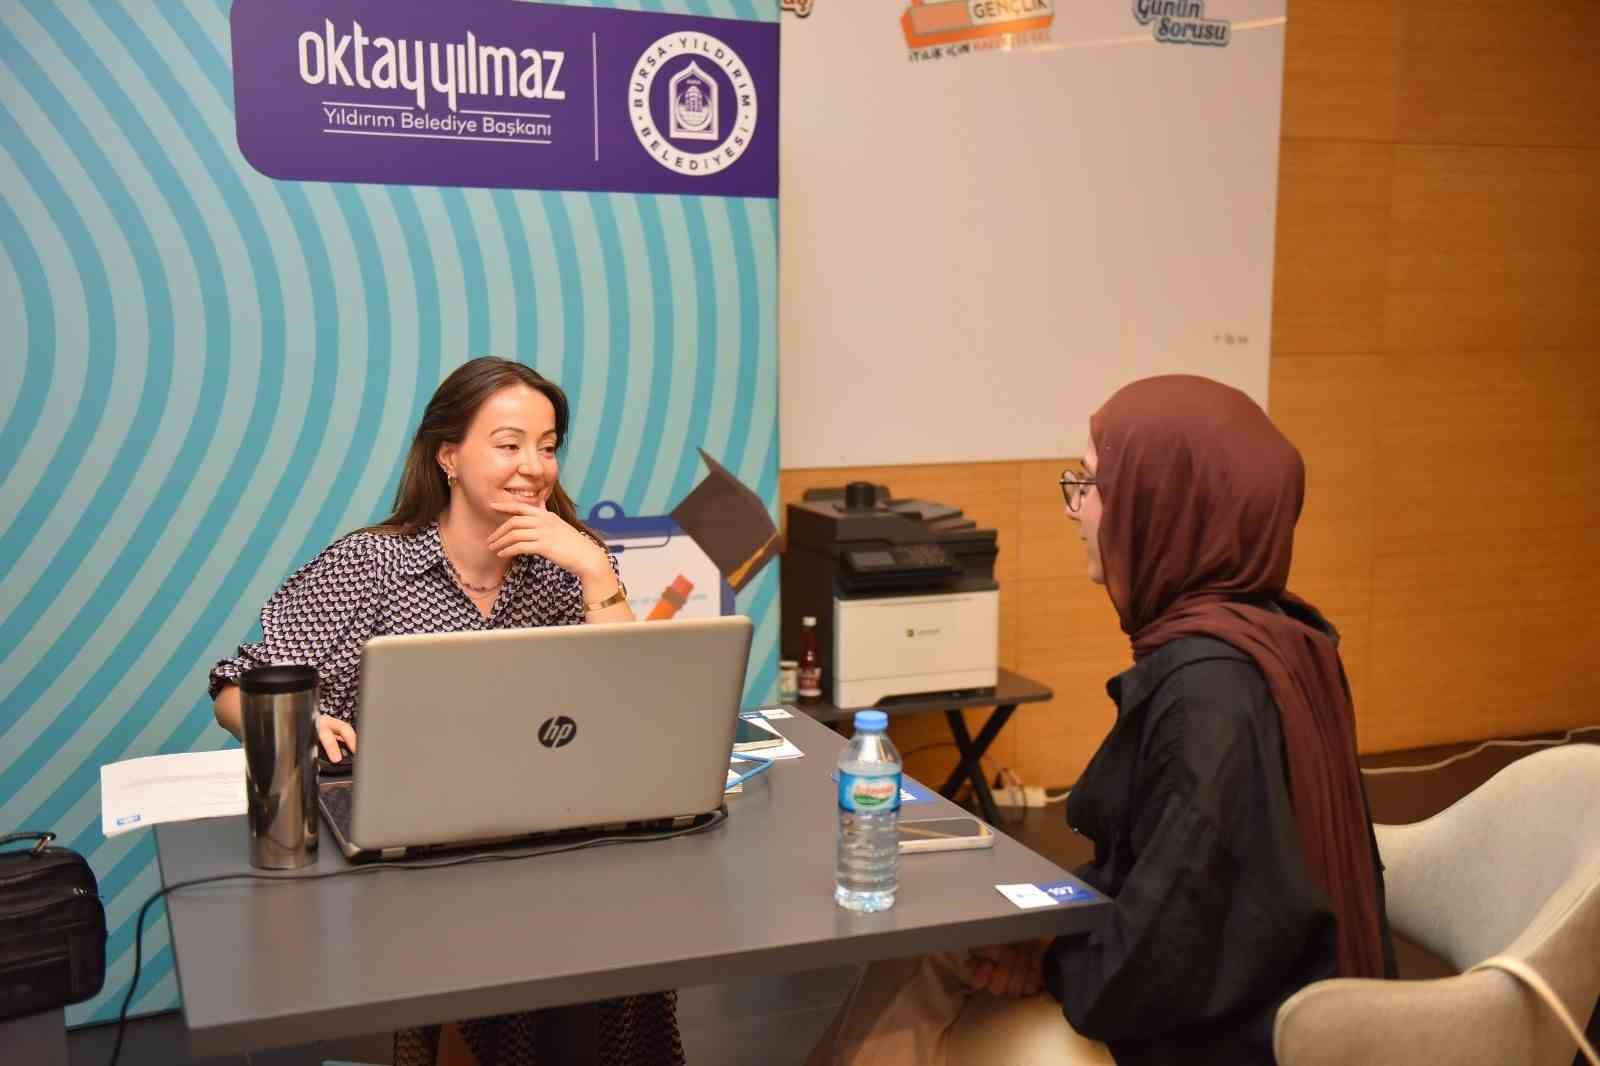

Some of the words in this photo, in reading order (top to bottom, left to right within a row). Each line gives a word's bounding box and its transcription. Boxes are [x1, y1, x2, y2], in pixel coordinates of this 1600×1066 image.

[1158, 17, 1226, 40] Sorusu
[298, 17, 426, 111] oktay
[430, 28, 566, 113] yılmaz
[634, 46, 668, 108] BURSA
[679, 37, 752, 107] YILDIRIM
[323, 107, 395, 128] Yıldırım
[401, 112, 477, 134] Belediye
[482, 117, 552, 137] Başkanı
[541, 713, 575, 748] hp
